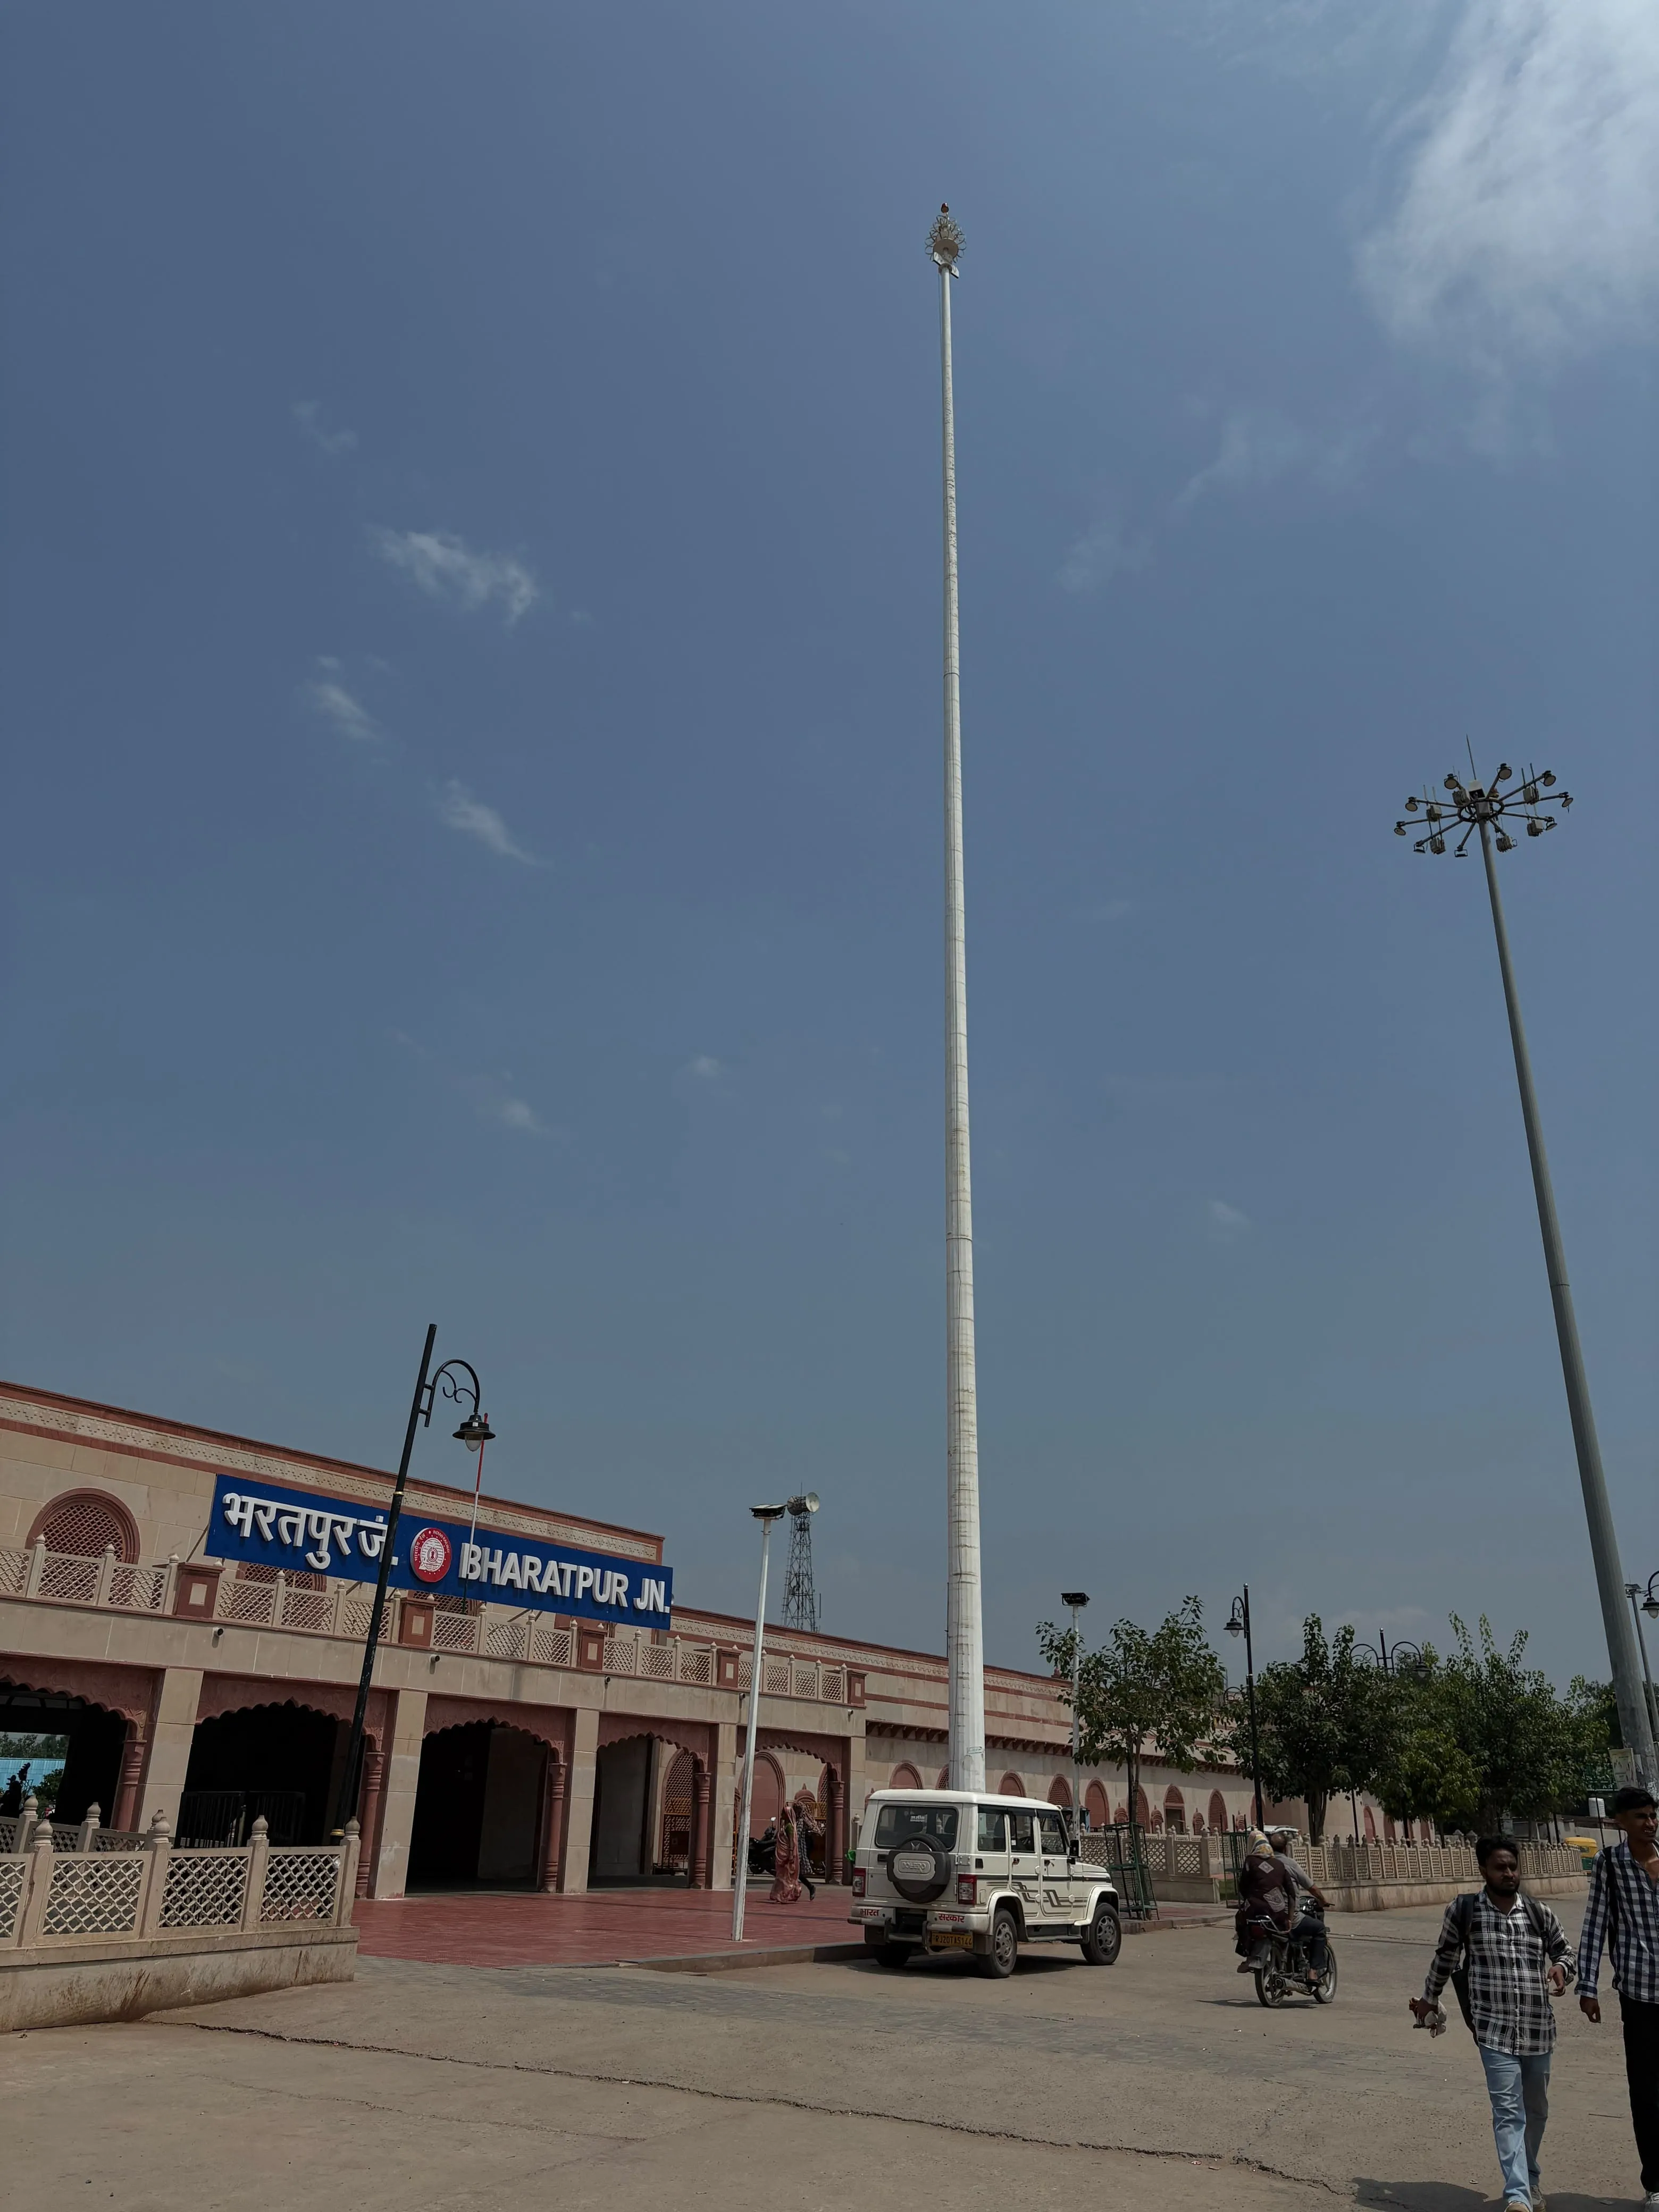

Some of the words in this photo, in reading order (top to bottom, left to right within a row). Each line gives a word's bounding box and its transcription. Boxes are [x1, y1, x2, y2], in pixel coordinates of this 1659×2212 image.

[222, 1493, 357, 1570] भरतपुर
[458, 1543, 629, 1607] BHARATPUR
[633, 1578, 670, 1613] JN.
[938, 1913, 965, 1923] सरकार
